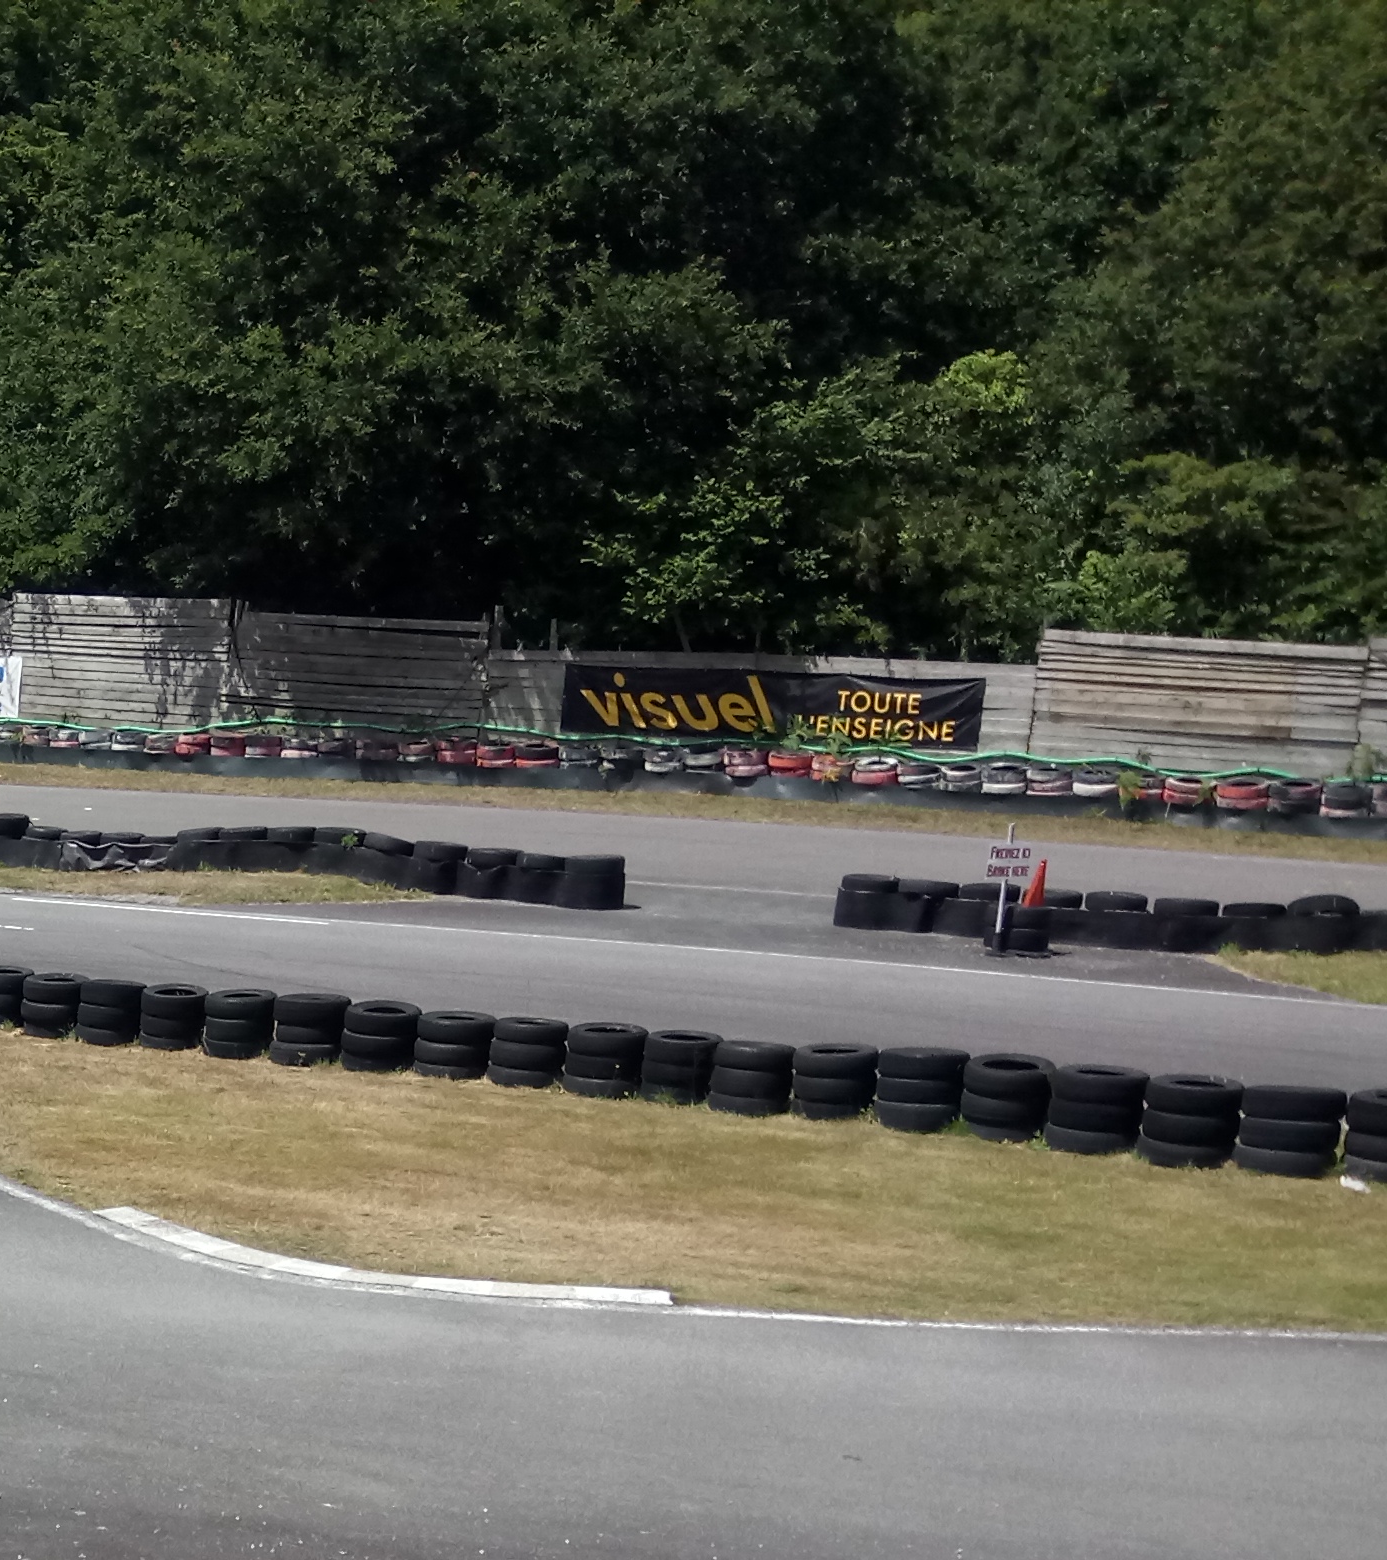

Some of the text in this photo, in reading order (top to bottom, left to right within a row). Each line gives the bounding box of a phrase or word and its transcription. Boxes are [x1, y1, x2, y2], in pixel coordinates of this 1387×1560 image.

[580, 672, 777, 734] visuel
[838, 689, 922, 714] TOUTE
[794, 714, 957, 743] 'ENSEIGNE
